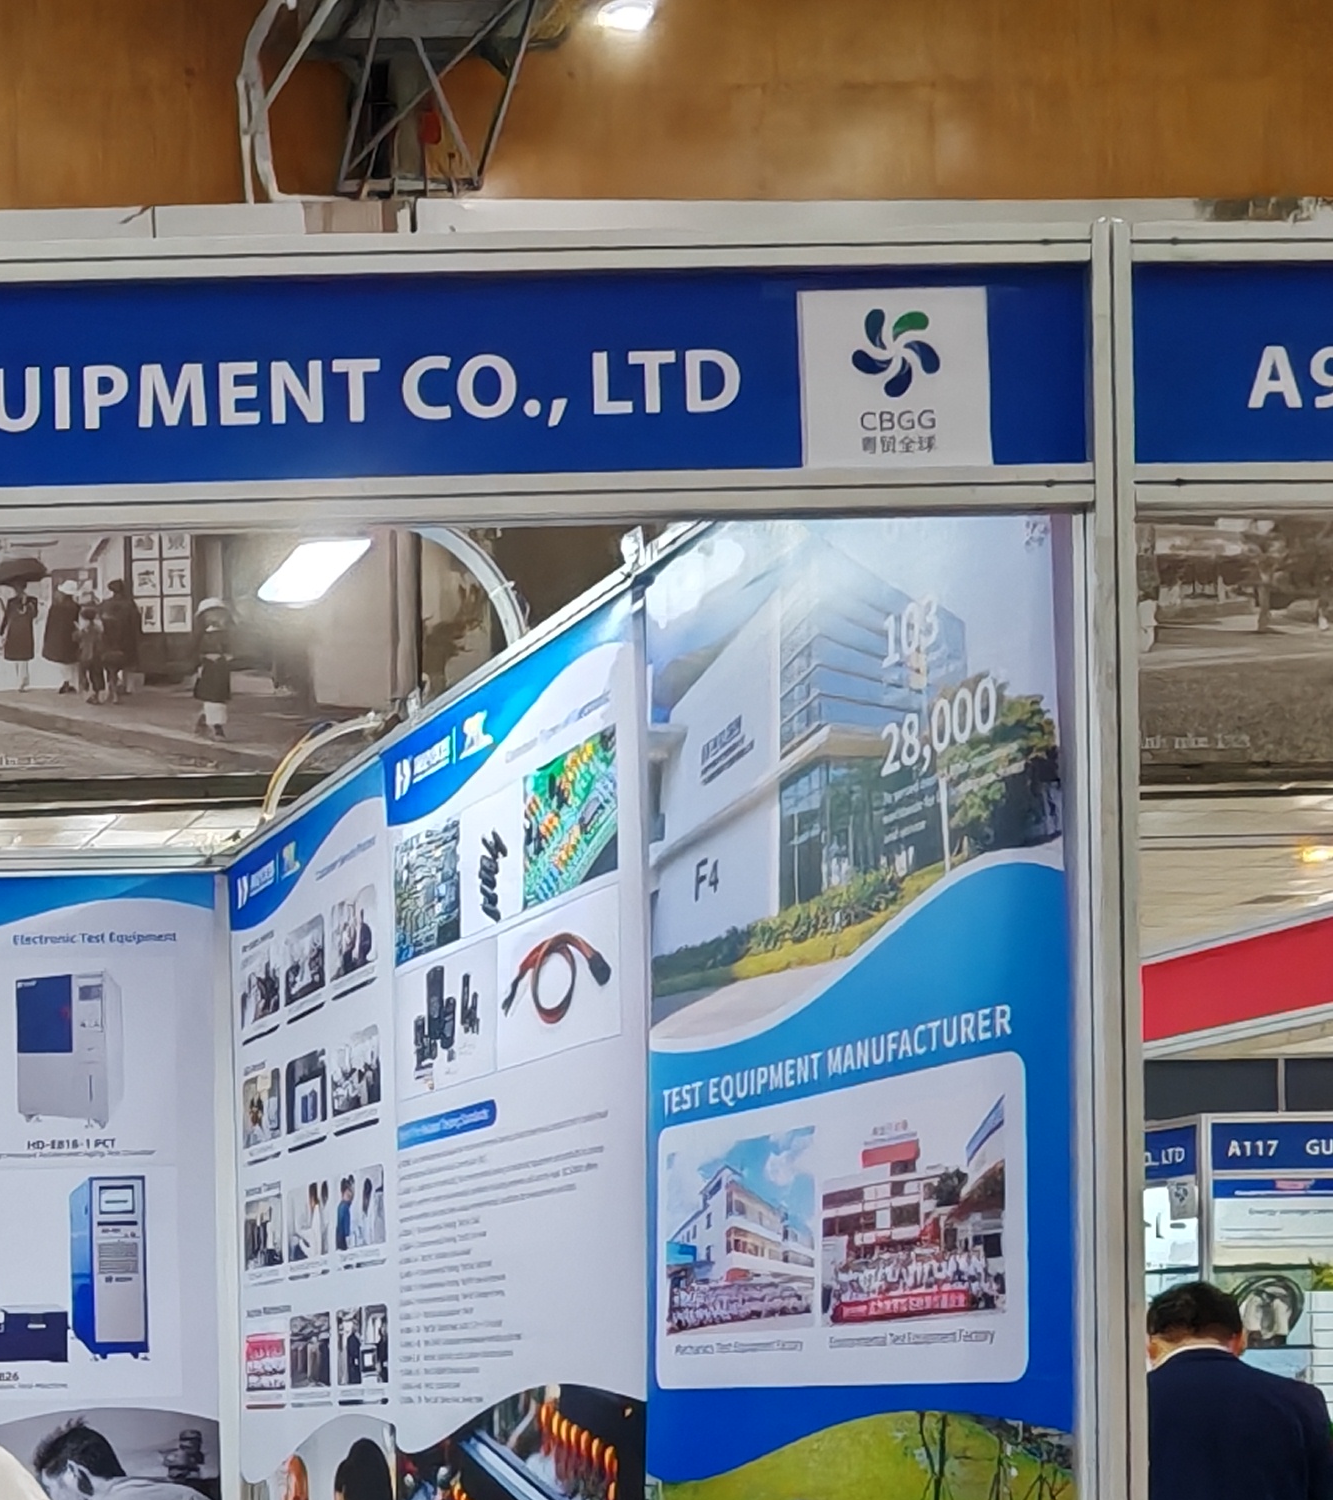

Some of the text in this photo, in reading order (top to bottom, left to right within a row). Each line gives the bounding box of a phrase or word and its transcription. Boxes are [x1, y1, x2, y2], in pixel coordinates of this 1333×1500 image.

[401, 353, 564, 428] CO.,
[592, 348, 742, 416] LTD
[860, 409, 937, 431] CBGG
[881, 675, 997, 777] 28,000
[694, 857, 720, 903] F4
[79, 932, 106, 945] Test
[662, 1003, 1012, 1118] TEST EQUIPMENT MANUFACTURER
[1227, 1139, 1279, 1158] A117
